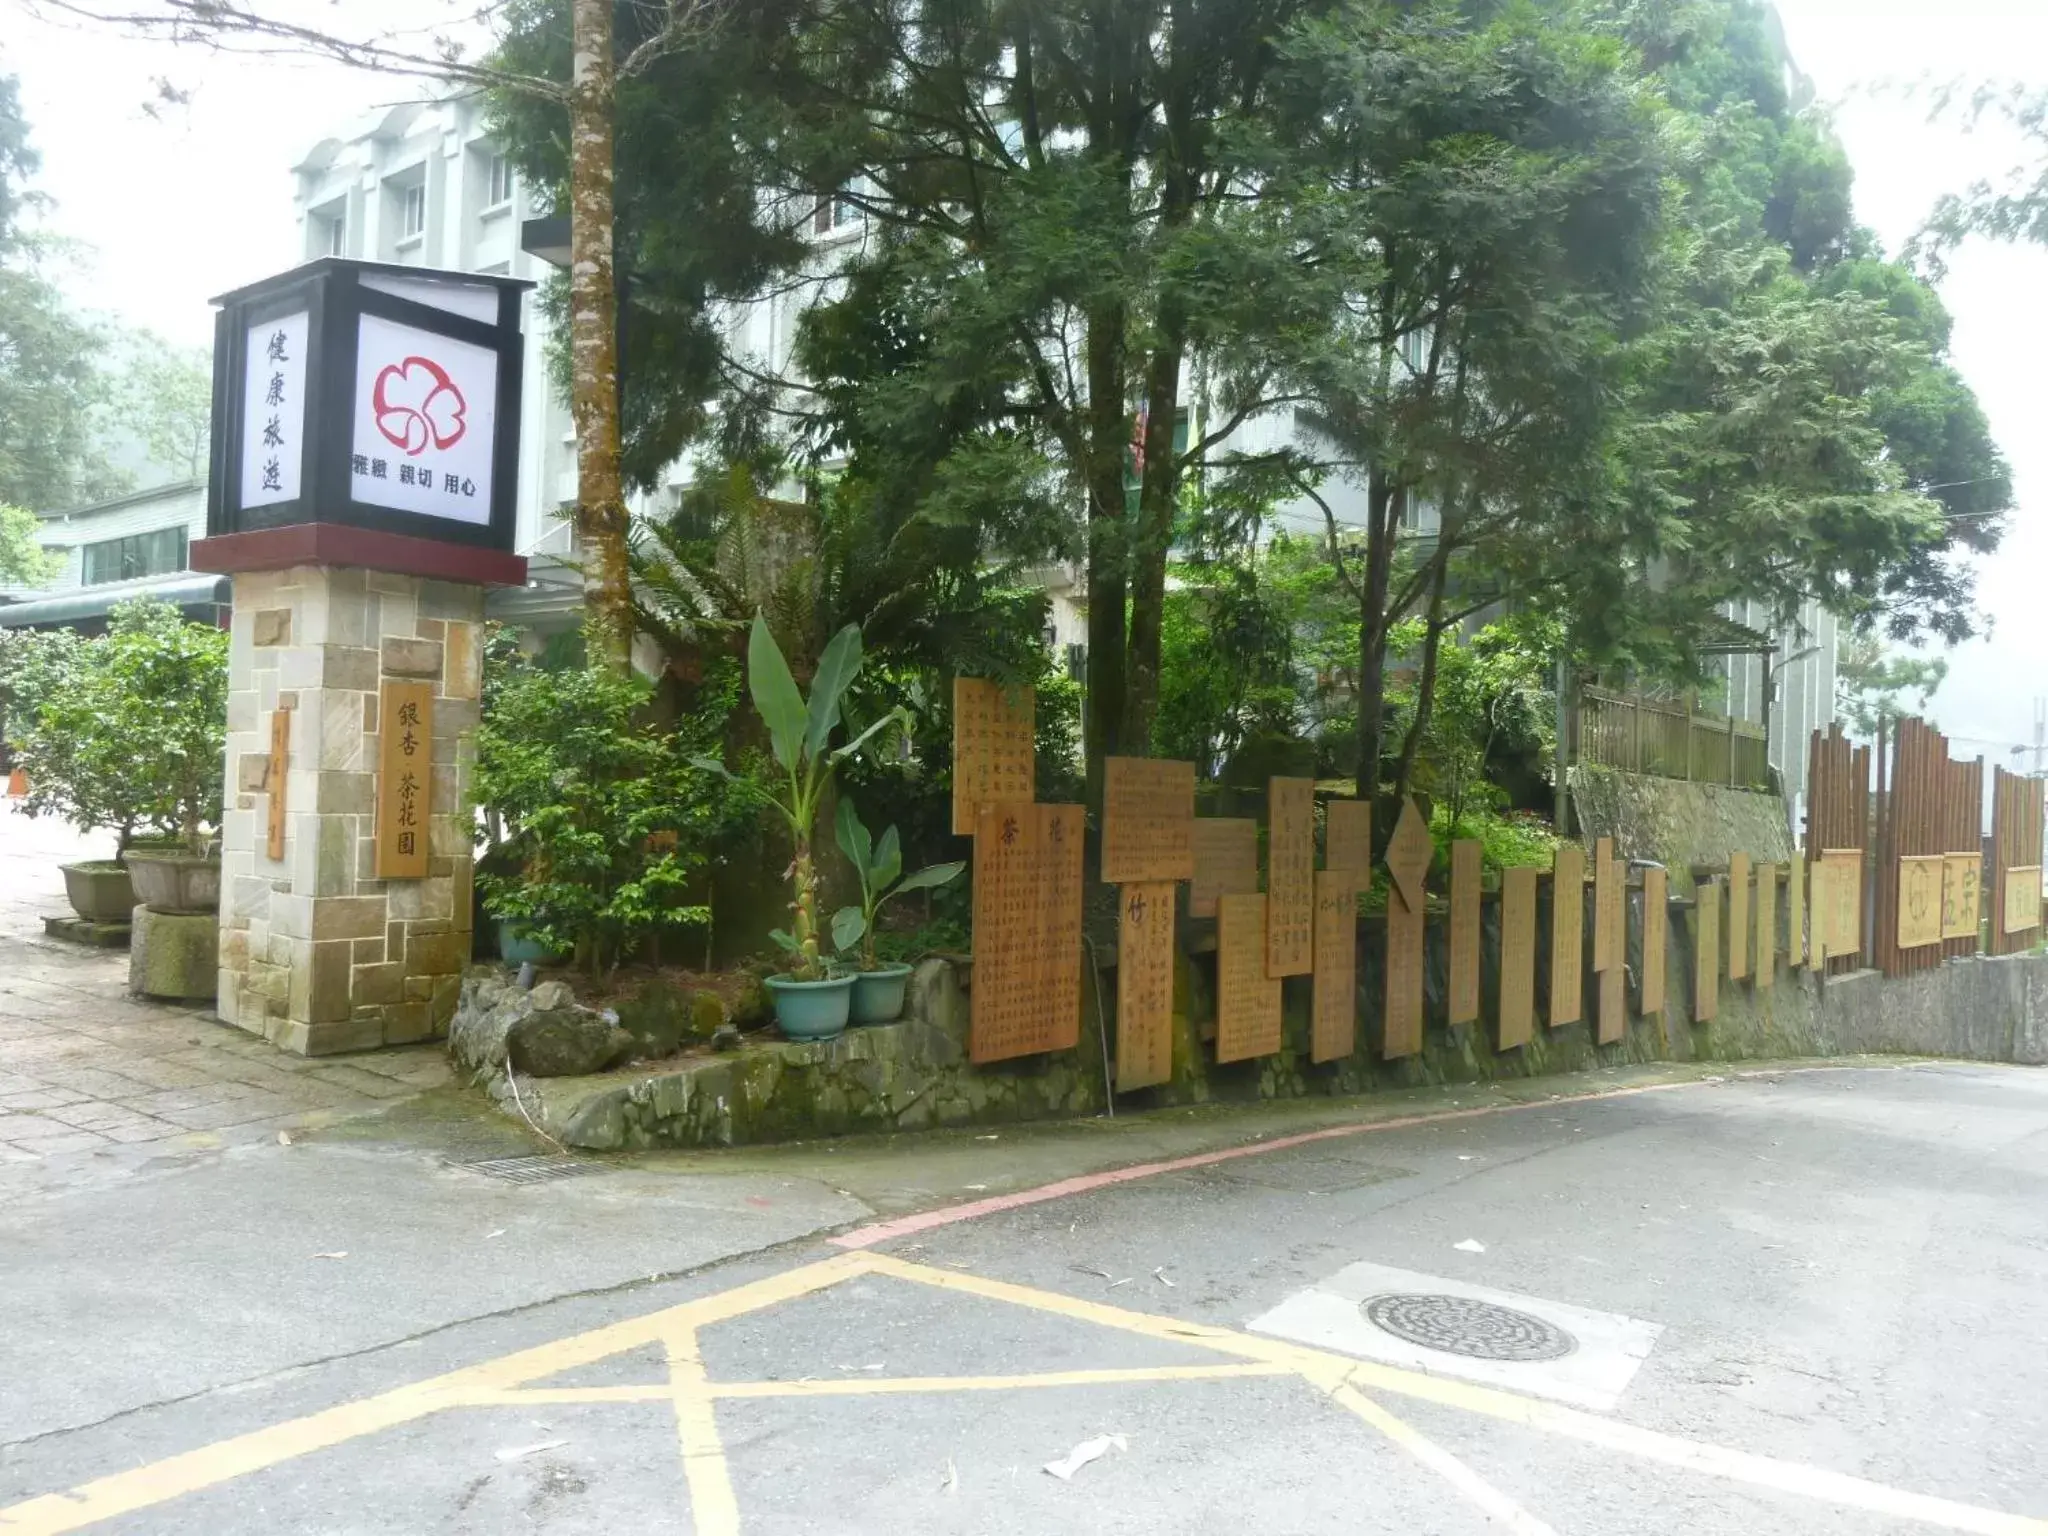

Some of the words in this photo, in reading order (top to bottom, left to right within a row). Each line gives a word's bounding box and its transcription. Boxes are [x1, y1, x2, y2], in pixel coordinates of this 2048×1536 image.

[261, 329, 290, 492] 健康旅遊
[352, 453, 388, 480] 雅緻
[399, 463, 433, 488] 親切
[443, 472, 476, 497] 用心
